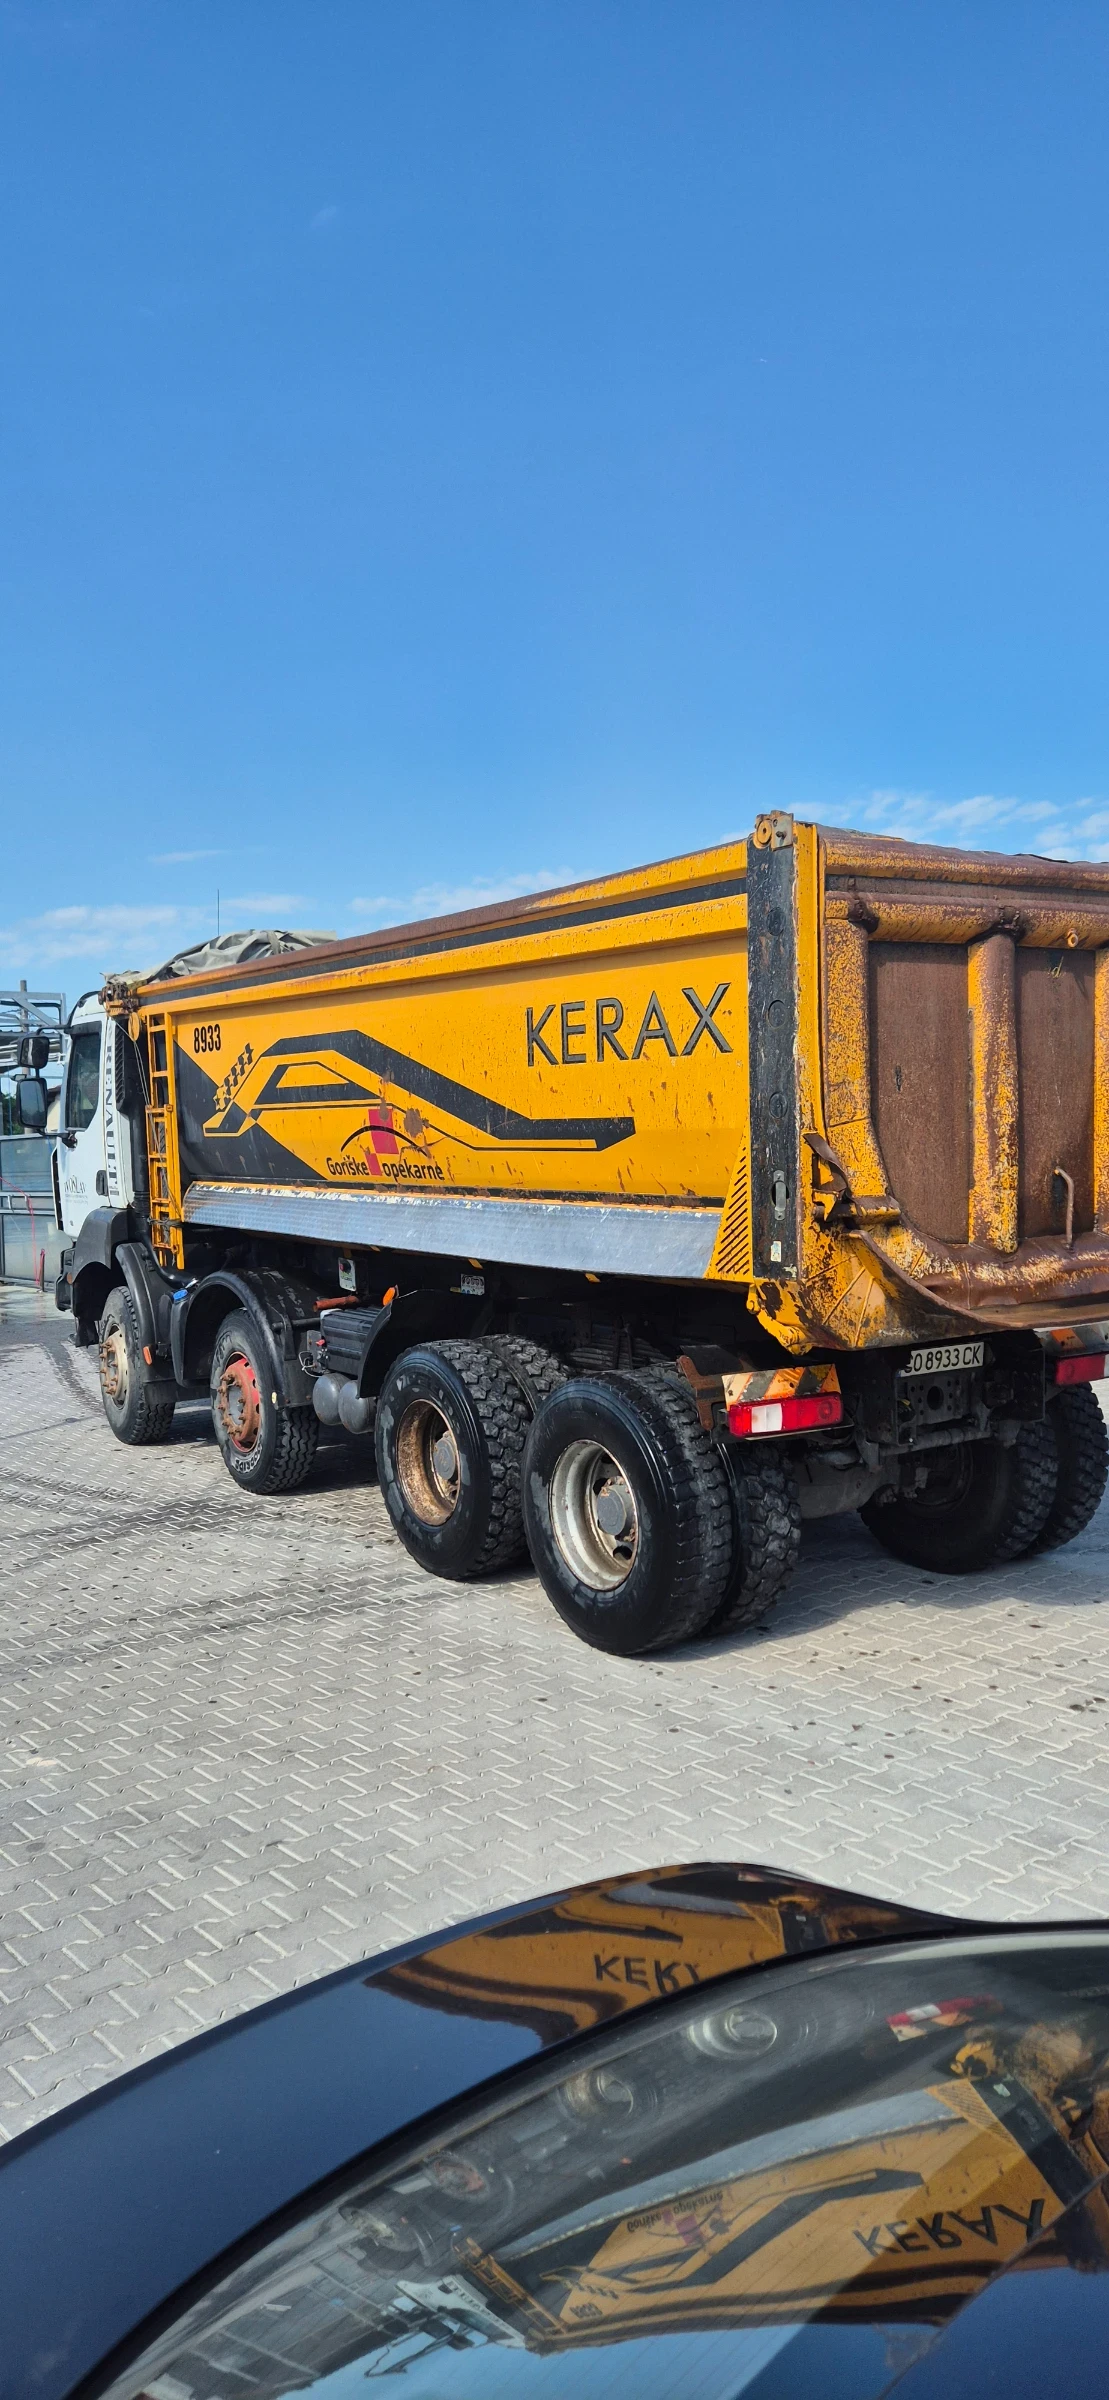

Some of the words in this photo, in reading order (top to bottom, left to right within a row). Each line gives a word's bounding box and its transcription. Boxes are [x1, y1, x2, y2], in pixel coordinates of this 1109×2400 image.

[193, 1023, 221, 1053] 8933
[526, 982, 733, 1067] KERAX
[105, 1045, 118, 1185] RENAULT
[326, 1155, 370, 1176] Goriške
[381, 1159, 445, 1182] opekarne
[925, 1348, 960, 1371] 8933
[963, 1344, 981, 1366] CK
